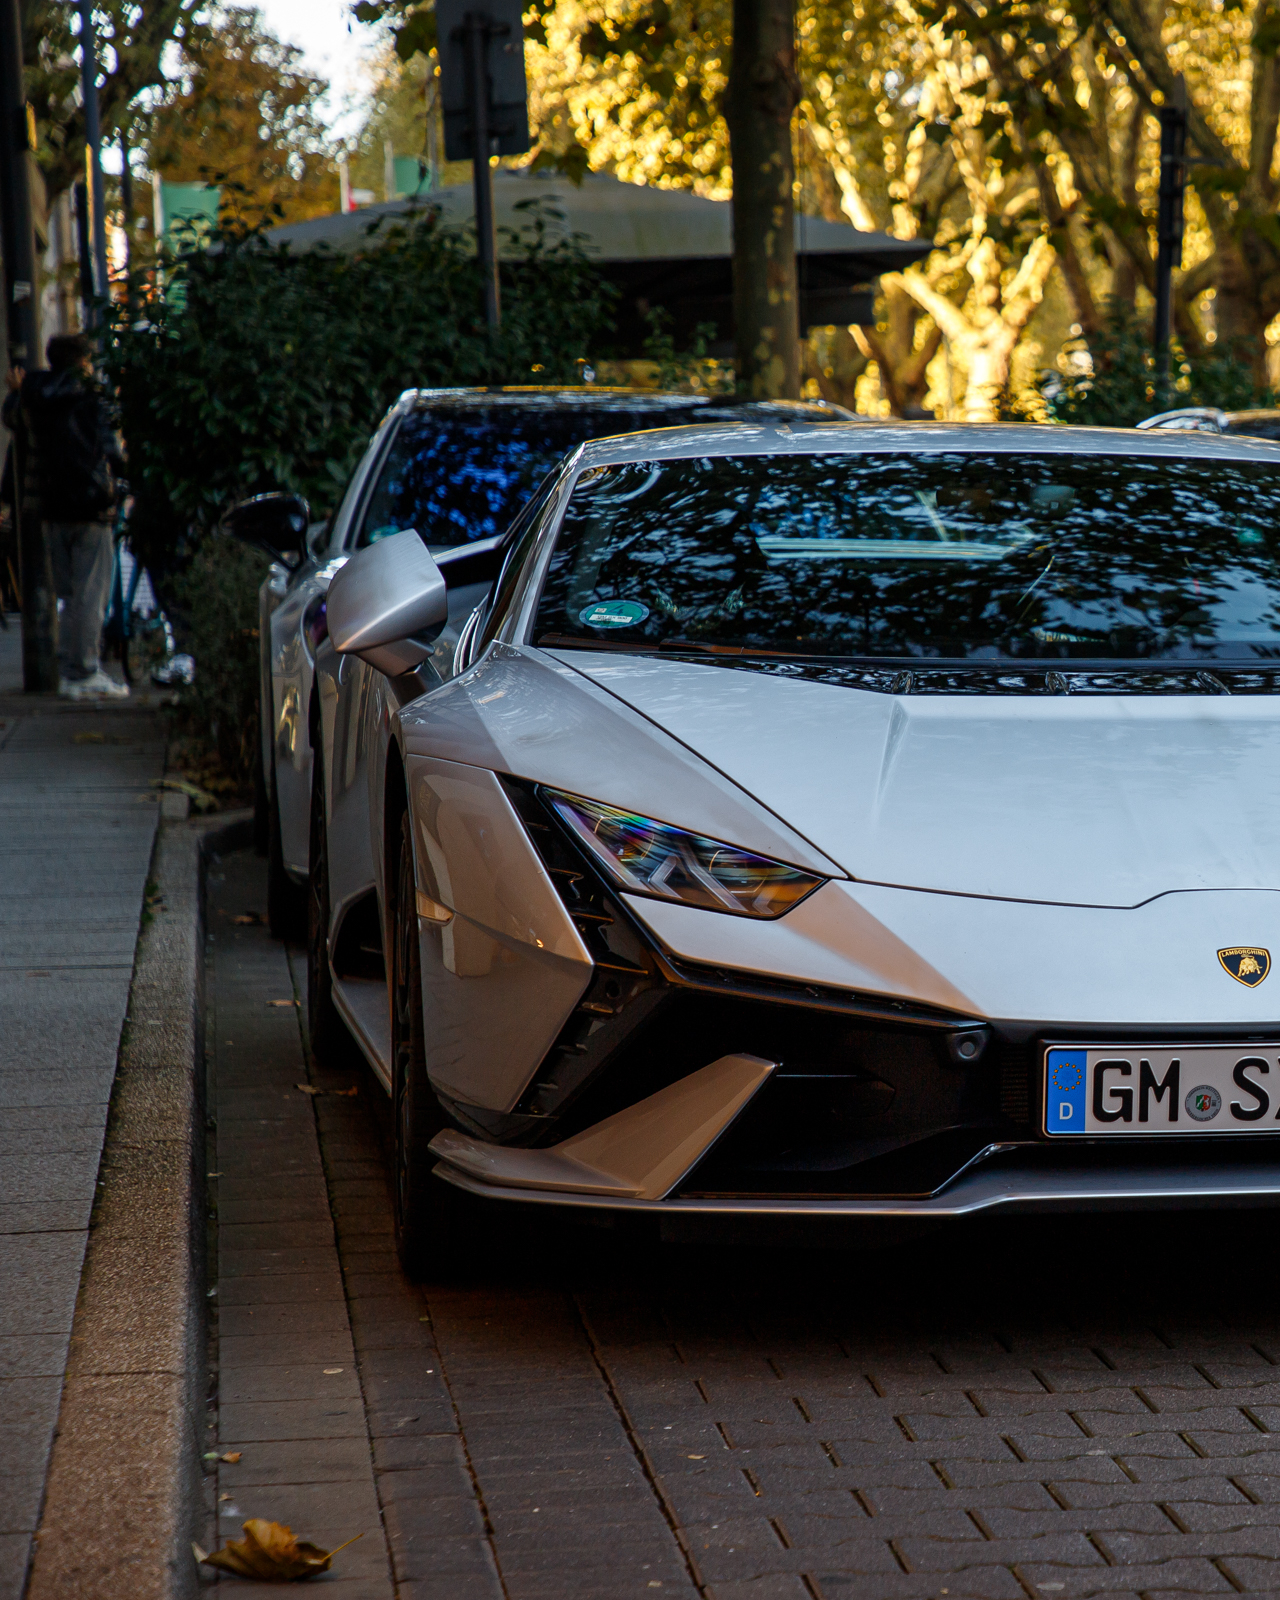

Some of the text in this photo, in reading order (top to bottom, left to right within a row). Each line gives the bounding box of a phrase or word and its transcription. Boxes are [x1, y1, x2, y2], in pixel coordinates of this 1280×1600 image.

[1222, 949, 1265, 958] LAMBORGHINI
[1093, 1058, 1180, 1123] GM
[1059, 1102, 1073, 1120] D
